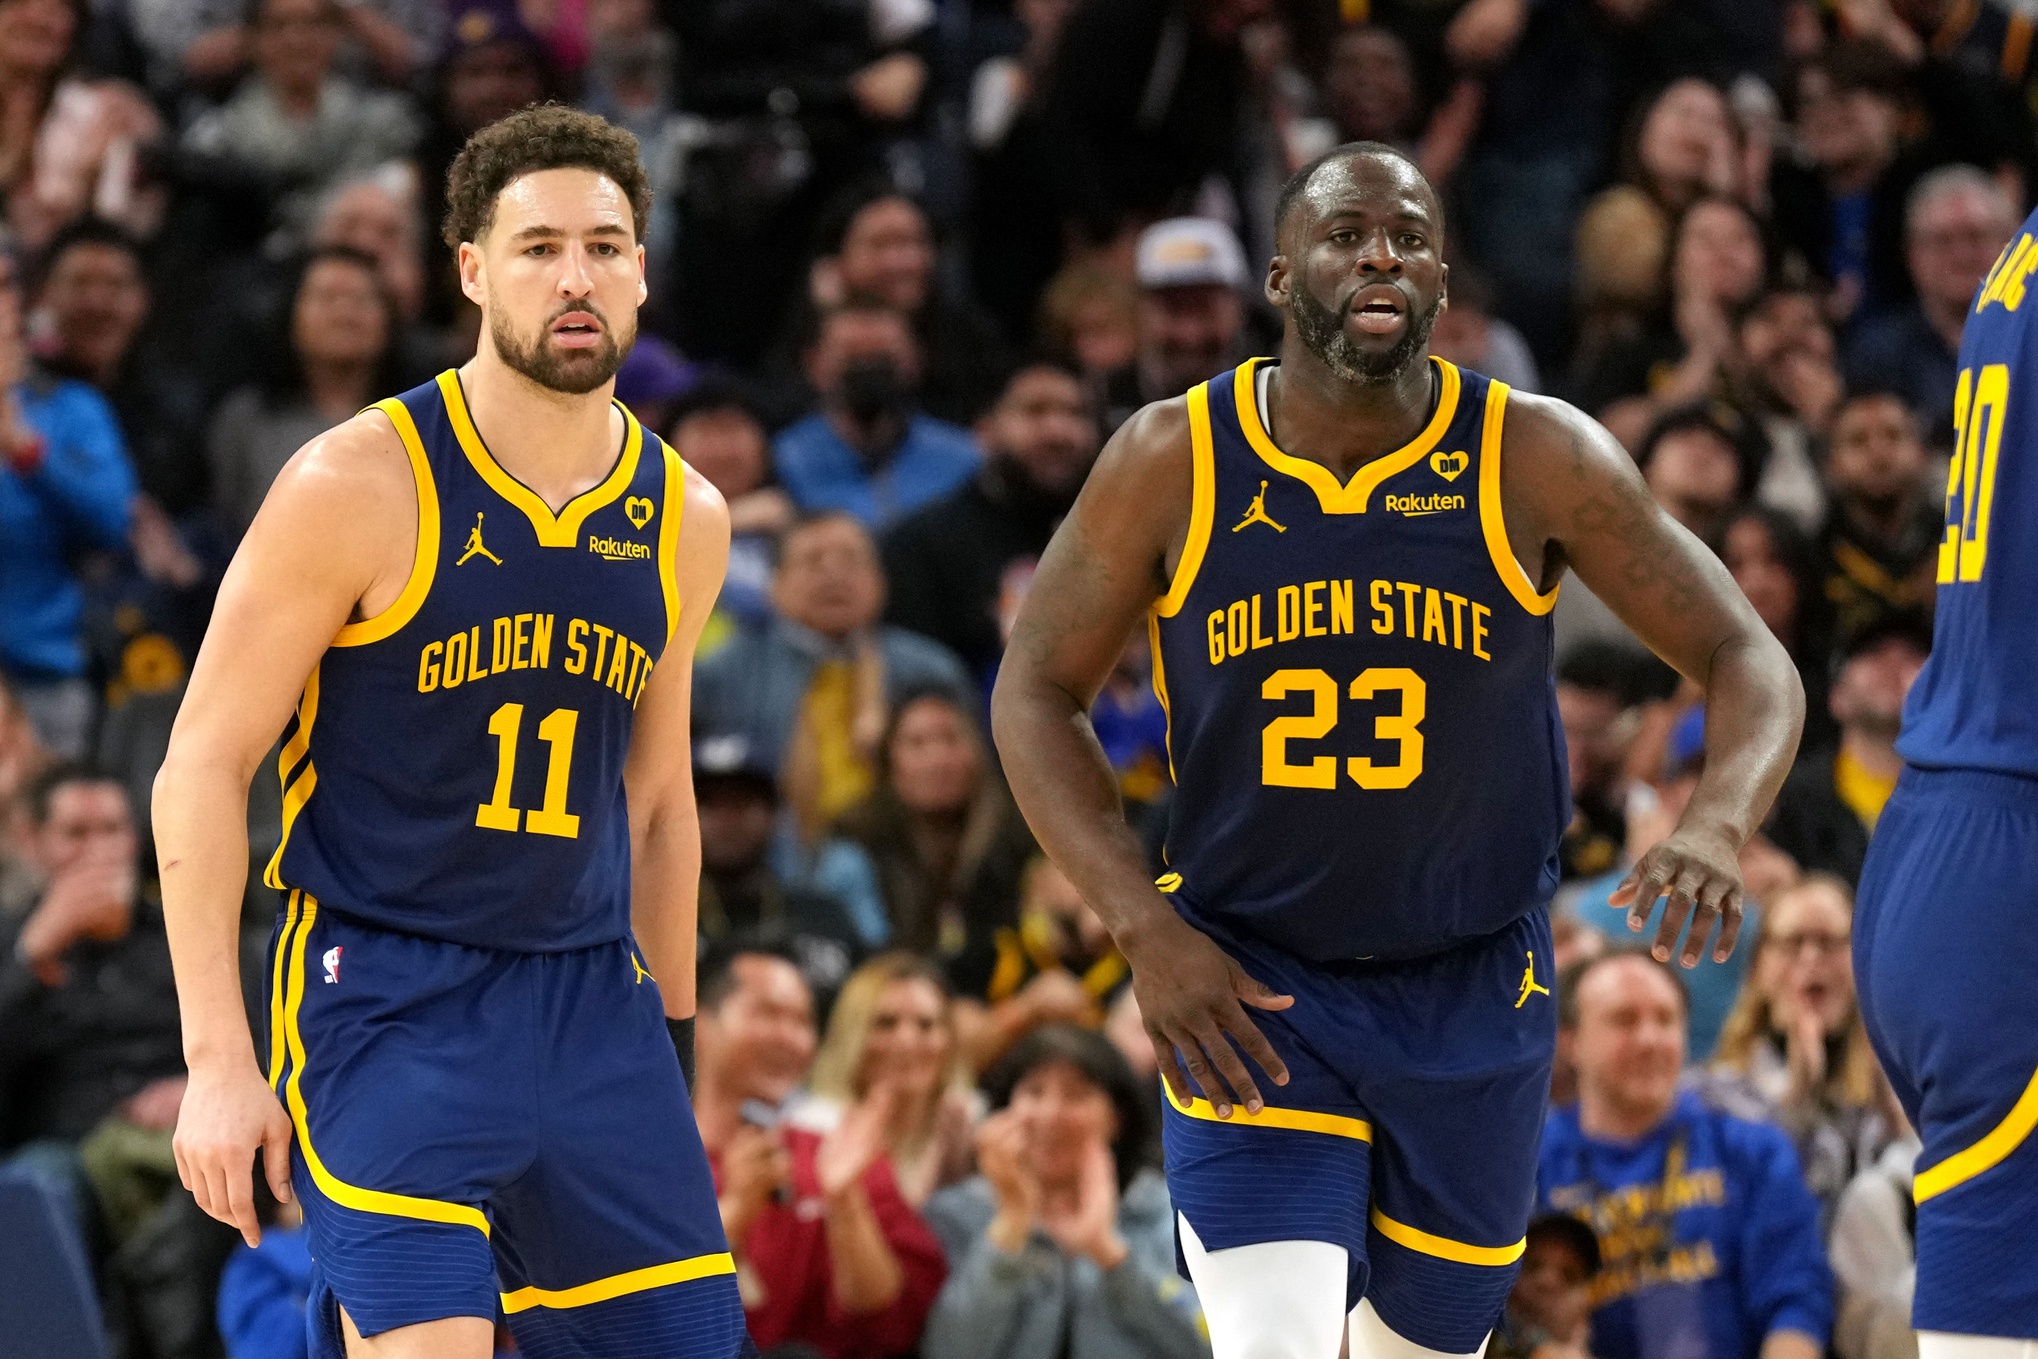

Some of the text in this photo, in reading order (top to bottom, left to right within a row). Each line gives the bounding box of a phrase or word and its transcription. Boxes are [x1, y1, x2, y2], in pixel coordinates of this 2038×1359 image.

[1440, 458, 1460, 473] DM
[631, 504, 647, 520] DM
[1385, 493, 1465, 512] Rakuten
[589, 535, 651, 559] Rakuten
[1207, 579, 1492, 666] GOLDEN STATE
[418, 613, 554, 693] GOLDEN
[1261, 667, 1427, 790] 23
[475, 702, 580, 839] 11
